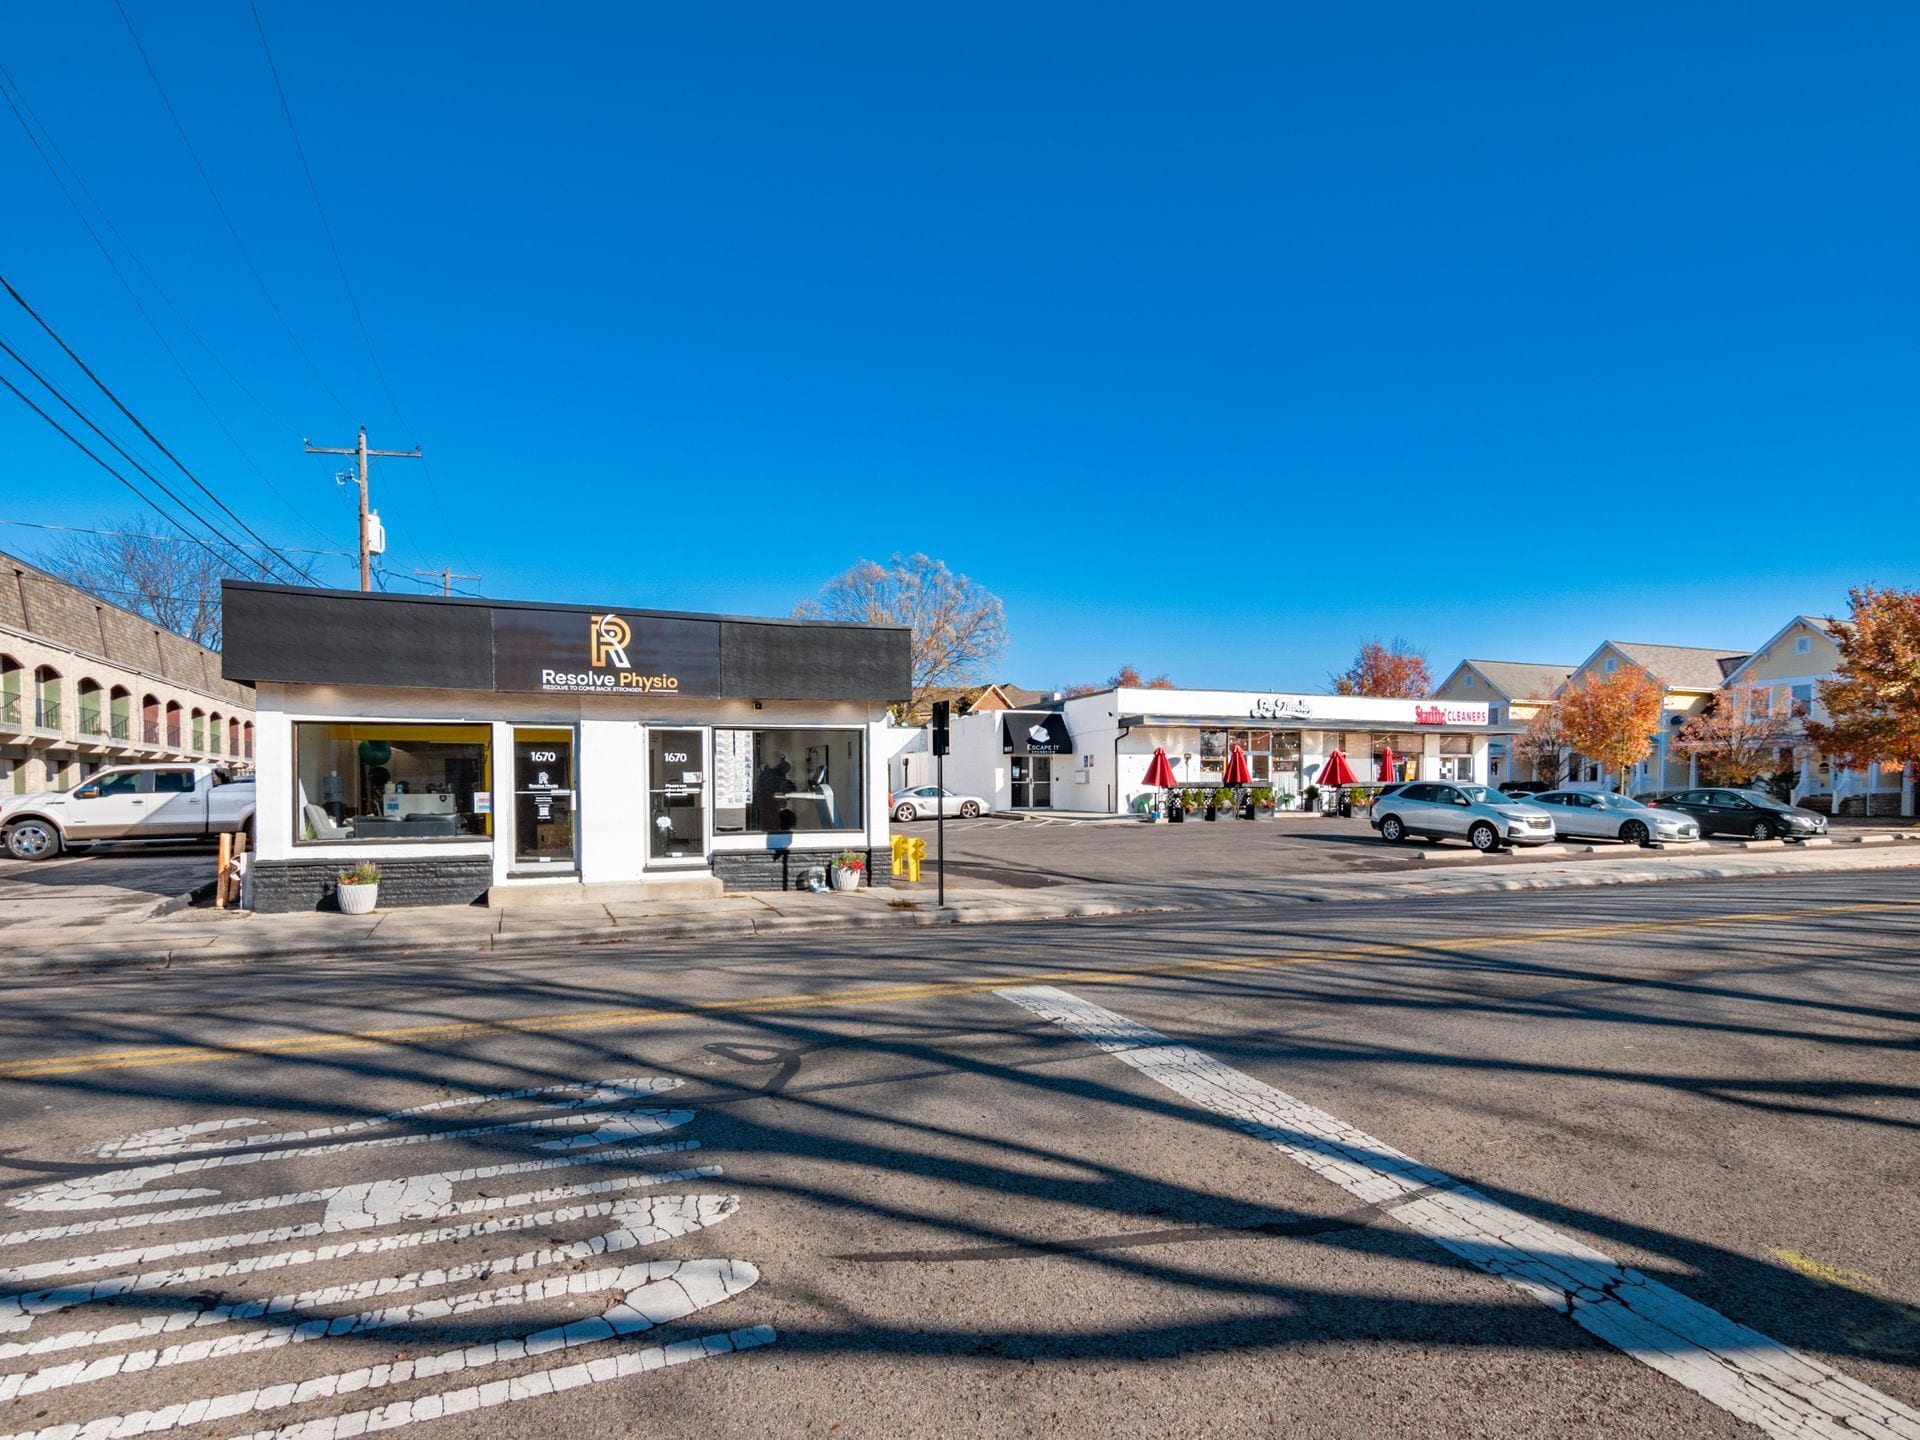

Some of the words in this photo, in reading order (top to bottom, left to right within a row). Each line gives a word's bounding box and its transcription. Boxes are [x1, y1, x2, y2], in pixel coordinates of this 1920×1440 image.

[542, 669, 615, 686] Resolve
[619, 672, 678, 693] Physio
[1447, 711, 1486, 722] CLEANERS
[530, 752, 556, 762] 1670
[664, 752, 687, 762] 1670
